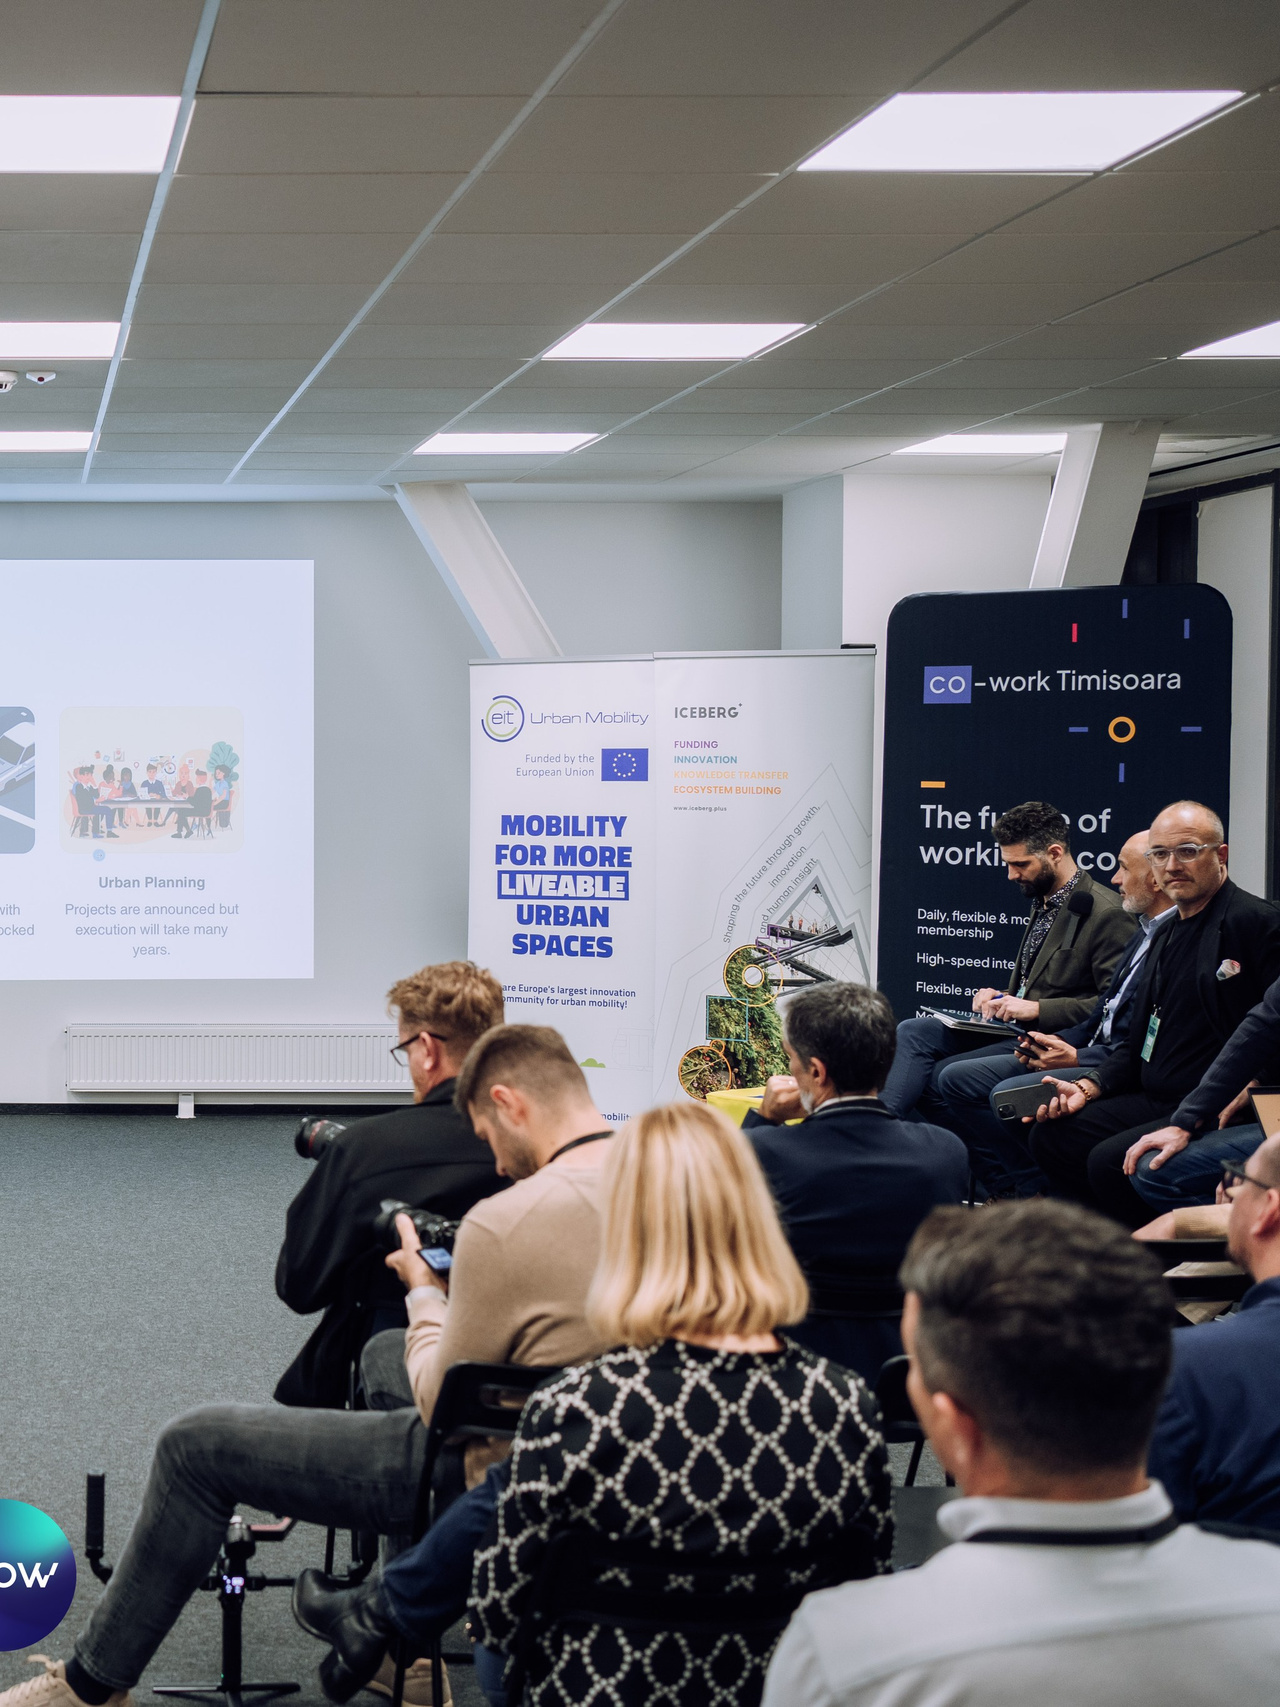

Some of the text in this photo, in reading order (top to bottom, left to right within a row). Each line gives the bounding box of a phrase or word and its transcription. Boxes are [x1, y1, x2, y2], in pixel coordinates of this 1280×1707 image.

[1056, 669, 1182, 692] Timisoara
[530, 711, 649, 725] Urban Mobility
[674, 740, 719, 749] FUNDING
[525, 753, 595, 765] Funded by the
[674, 755, 738, 764] INNOVATION
[516, 767, 595, 778] European Union
[673, 770, 789, 780] KNOWLEDGE TRANSFER
[673, 785, 782, 795] ECOSYSTEM BUILDING
[501, 814, 628, 837] MOBILITY
[920, 804, 972, 829] The
[1077, 807, 1112, 833] of
[495, 844, 632, 868] FOR MORE
[919, 841, 1007, 867] worki
[768, 845, 807, 888] innovation
[98, 876, 206, 890] Urban Planning
[500, 873, 626, 899] LIVEABLE
[723, 903, 741, 944] Shaping
[734, 888, 748, 903] the
[745, 864, 768, 891] future
[765, 834, 795, 866] through
[65, 903, 240, 918] Projects are announced but
[516, 904, 610, 928] URBAN
[759, 914, 770, 934] and
[766, 885, 795, 915] human
[917, 908, 950, 923] Daily,
[952, 910, 997, 923] flexible
[998, 913, 1008, 924] &
[75, 924, 229, 937] execution will take many
[917, 925, 994, 941] membership
[132, 946, 171, 958] years.
[512, 933, 613, 958] SPACES
[916, 952, 1016, 970] High-speed inte
[518, 984, 556, 995] Europe's
[557, 985, 588, 996] largest
[589, 987, 636, 998] innovation
[916, 981, 962, 995] Flexible
[502, 995, 628, 1010] ommunity for urban mobility!
